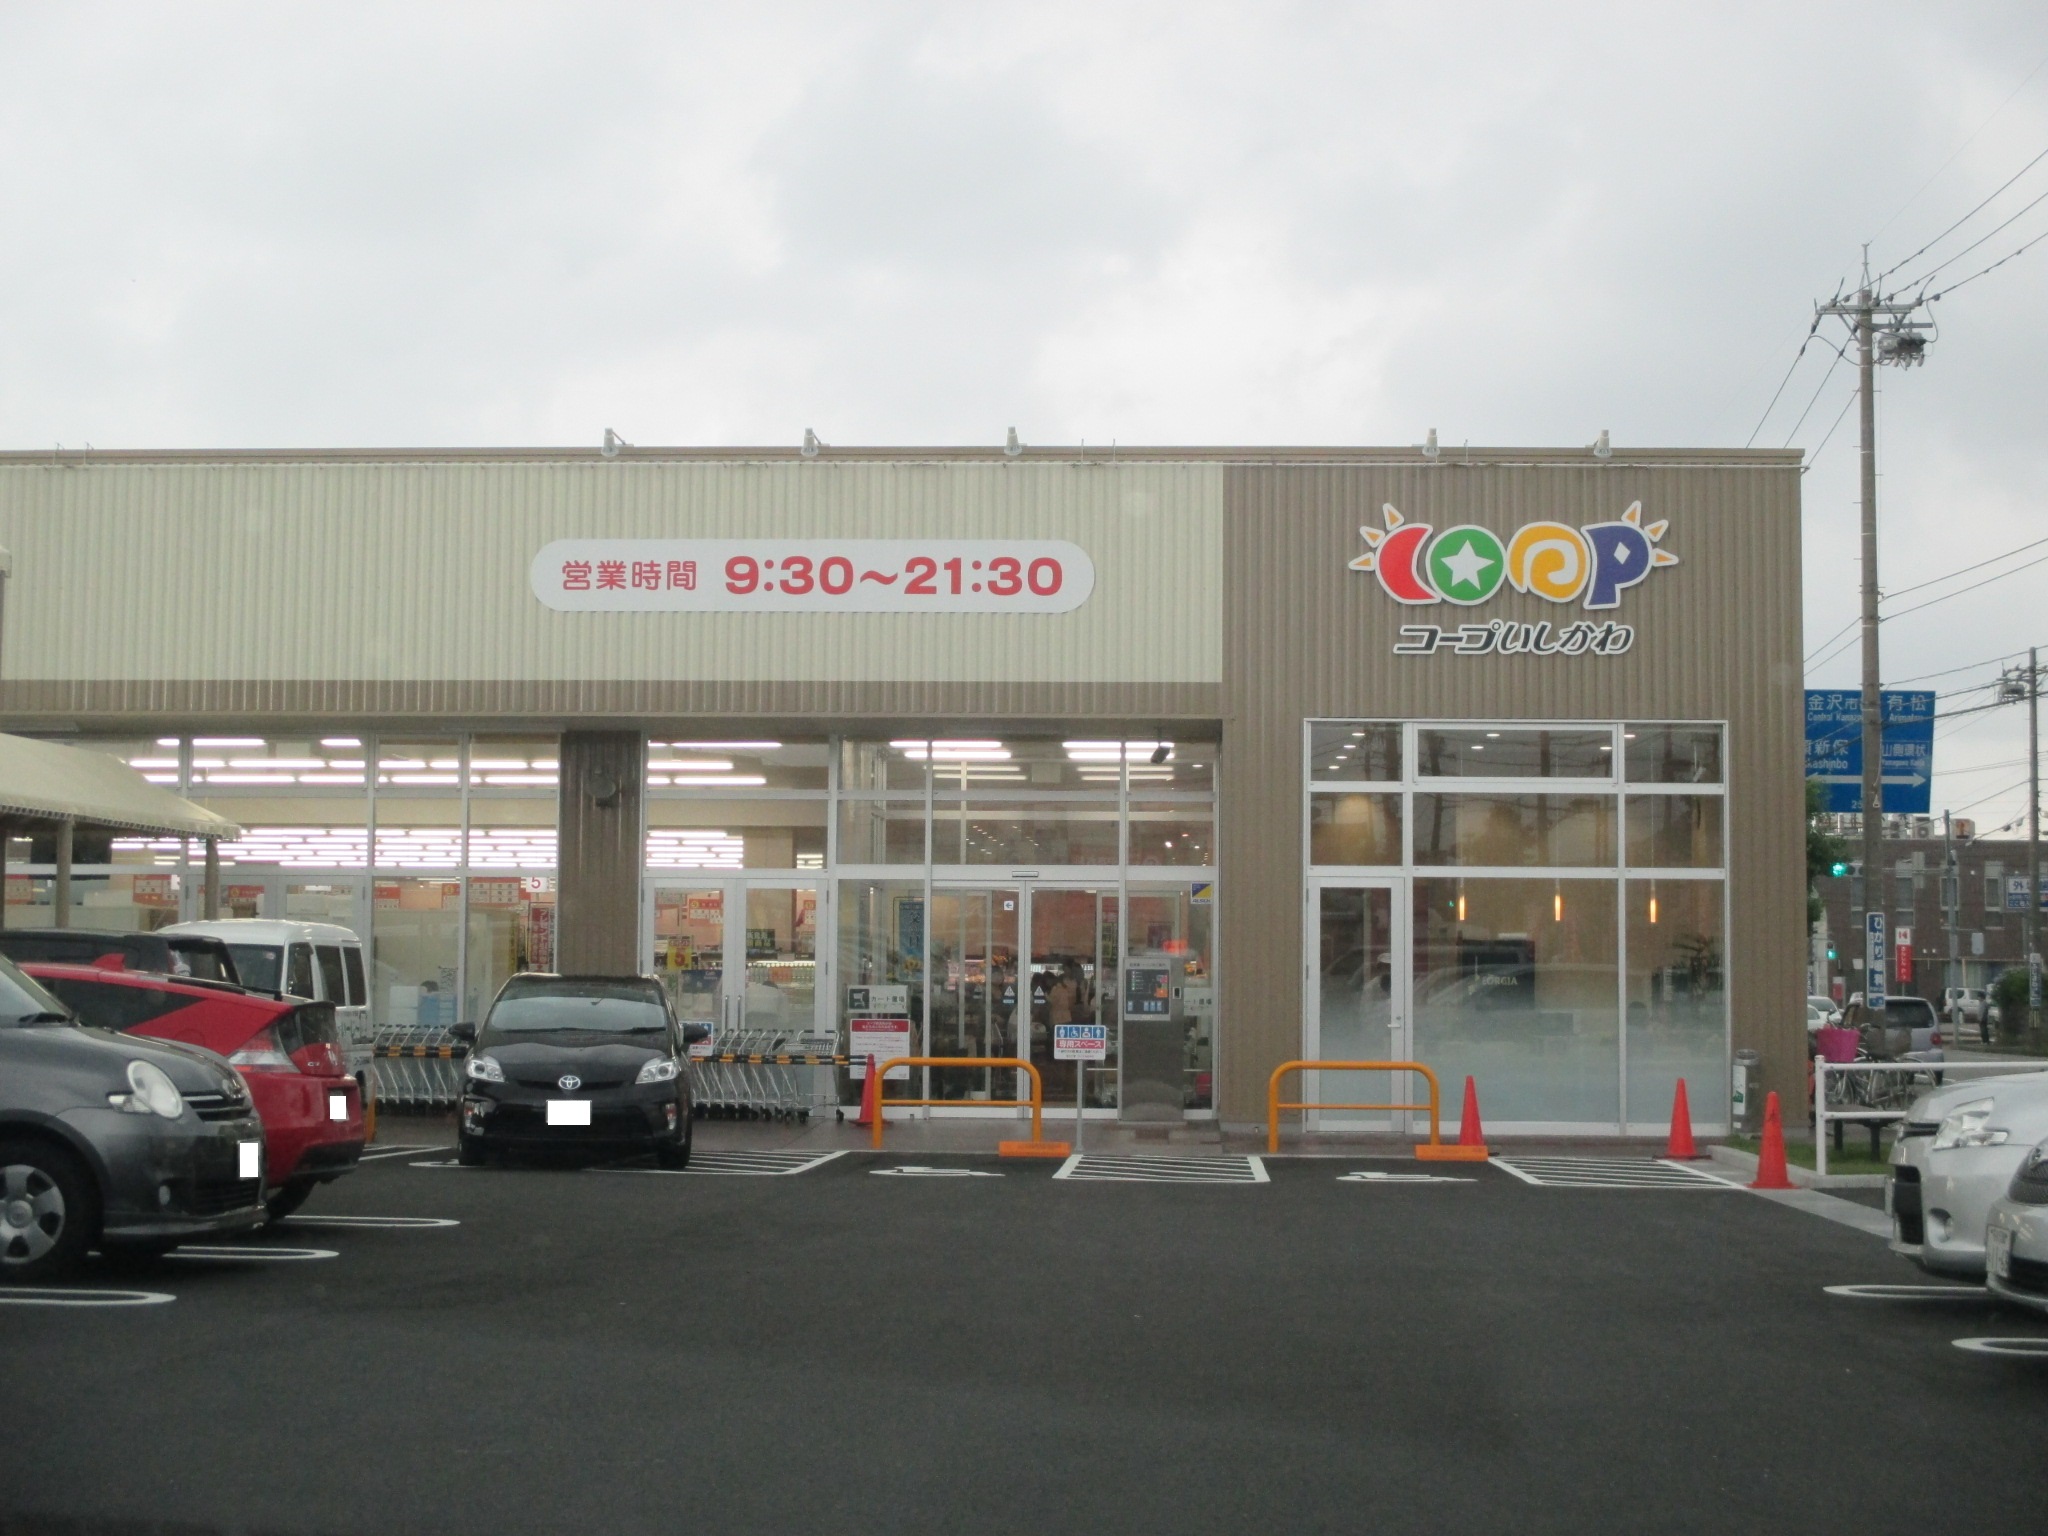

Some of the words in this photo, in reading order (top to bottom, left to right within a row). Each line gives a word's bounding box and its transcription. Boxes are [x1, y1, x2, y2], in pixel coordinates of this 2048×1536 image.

[1376, 522, 1652, 608] COOP
[561, 559, 697, 591] 営業時間
[1395, 620, 1634, 654] コープいしかわ
[1807, 694, 1863, 711] 金沢市
[1886, 694, 1926, 711] 有松
[531, 877, 541, 889] 5
[1059, 1039, 1102, 1048] 専用スペース
